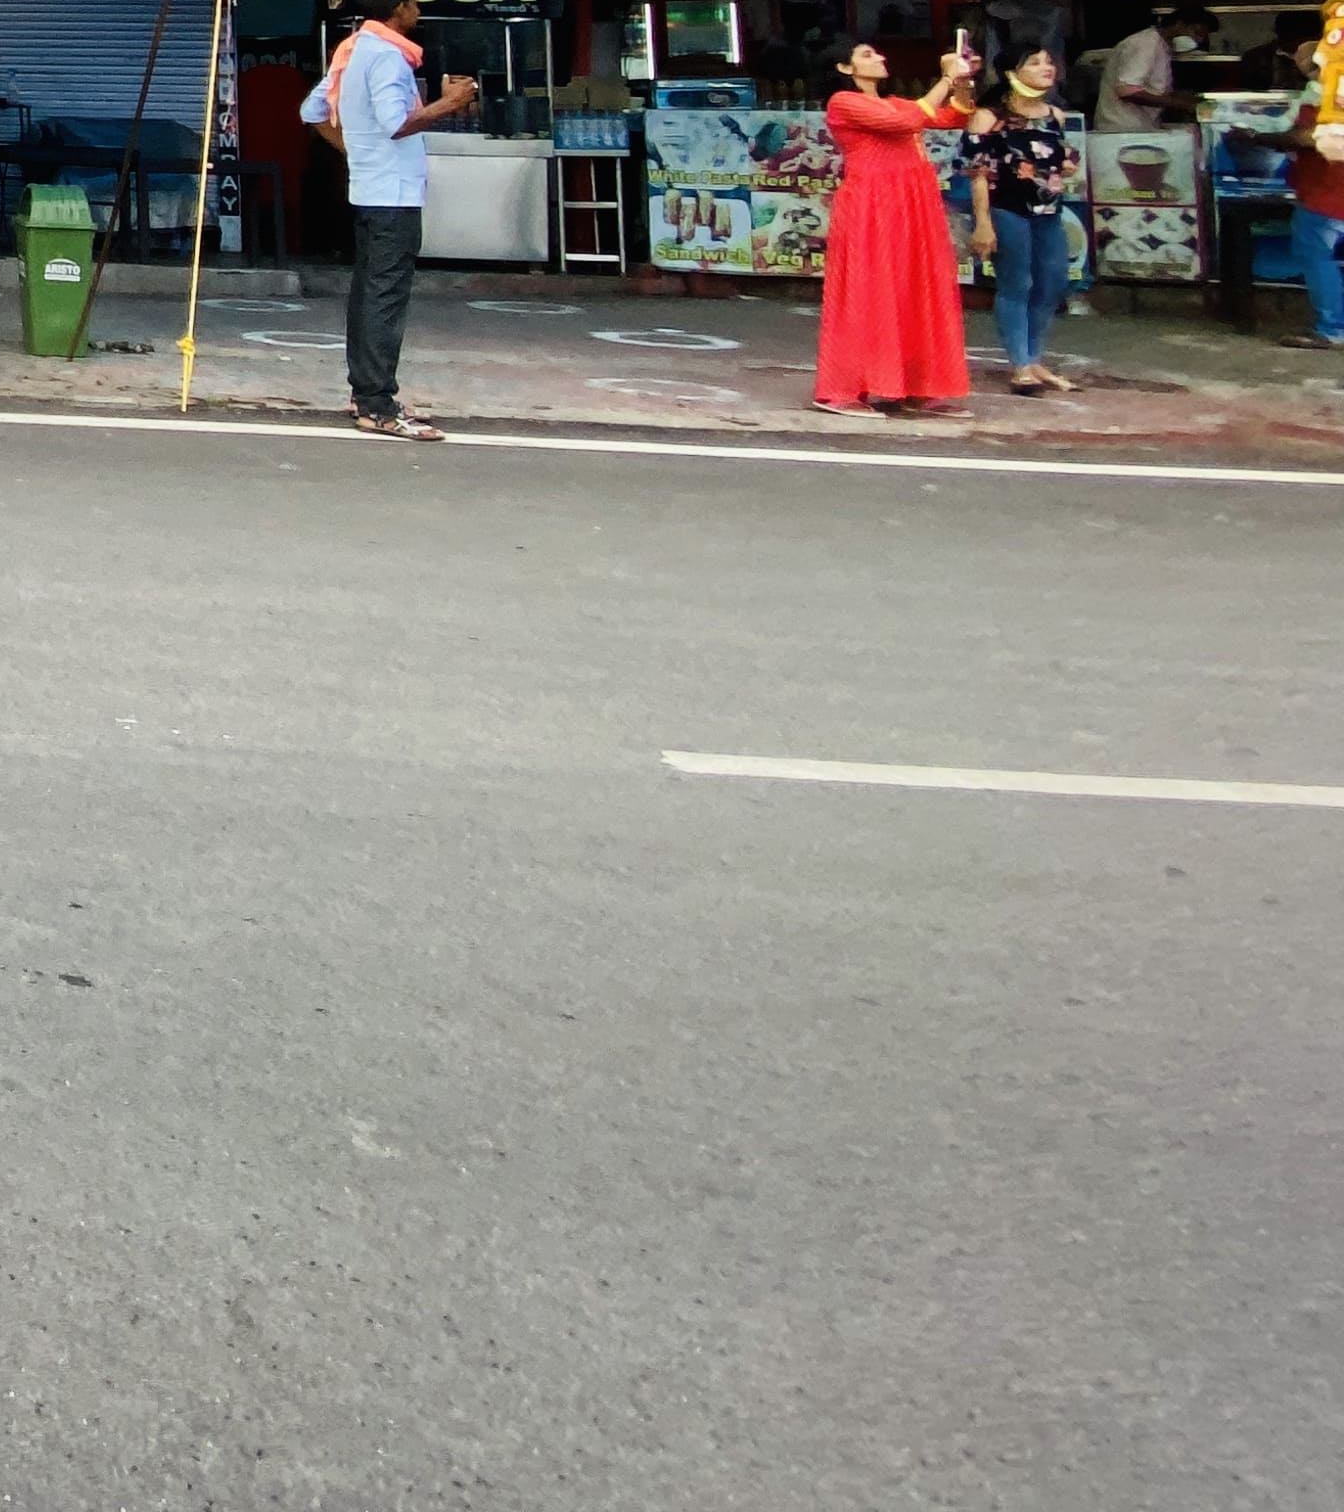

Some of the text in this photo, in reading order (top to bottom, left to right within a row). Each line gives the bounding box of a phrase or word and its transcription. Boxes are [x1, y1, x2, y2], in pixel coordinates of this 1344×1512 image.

[648, 170, 697, 184] White
[752, 172, 792, 187] Red
[655, 243, 751, 266] Sandwich
[763, 248, 805, 267] Veg
